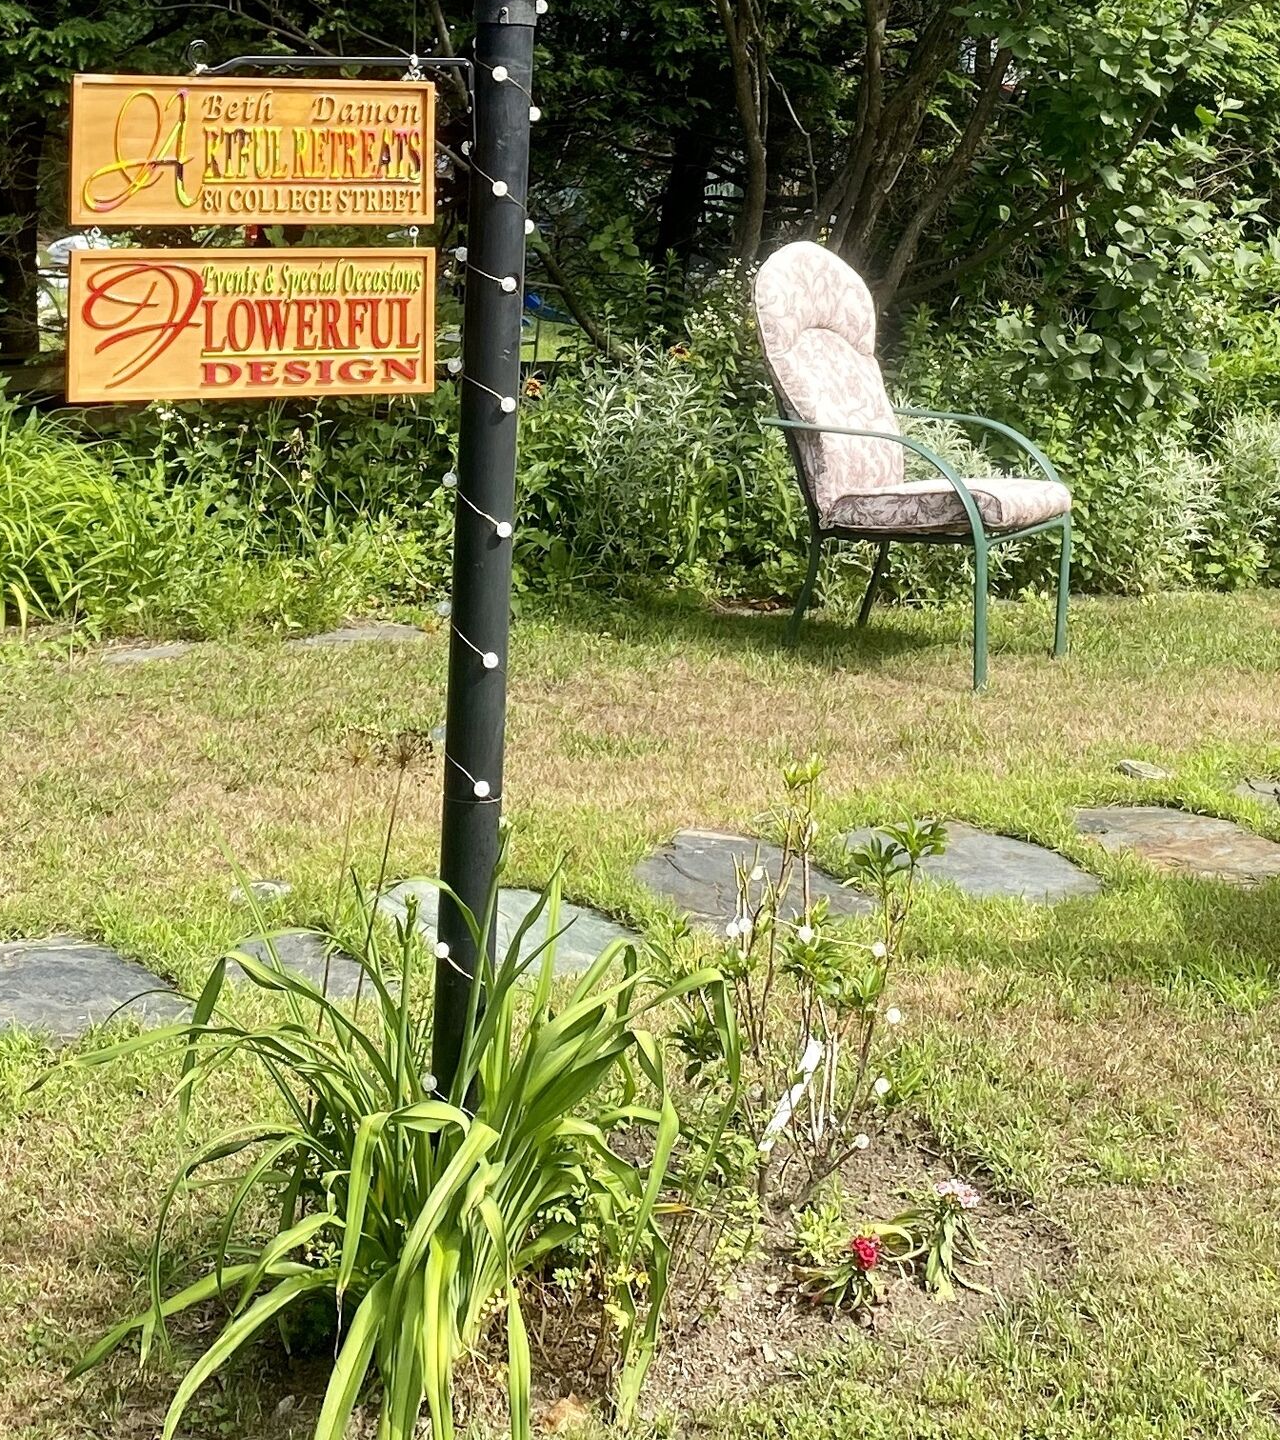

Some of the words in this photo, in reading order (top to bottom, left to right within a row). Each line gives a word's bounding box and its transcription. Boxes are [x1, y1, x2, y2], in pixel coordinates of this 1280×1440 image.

[202, 90, 273, 123] Beth
[311, 94, 421, 126] Damon
[291, 127, 422, 182] RETREATS
[202, 189, 223, 212] 80
[229, 188, 331, 213] COLLEGE
[335, 189, 421, 214] STREET
[202, 264, 260, 296] Events
[264, 266, 275, 292] &
[278, 258, 345, 303] Special
[342, 261, 422, 296] Occasions
[200, 358, 420, 388] DESIGN
